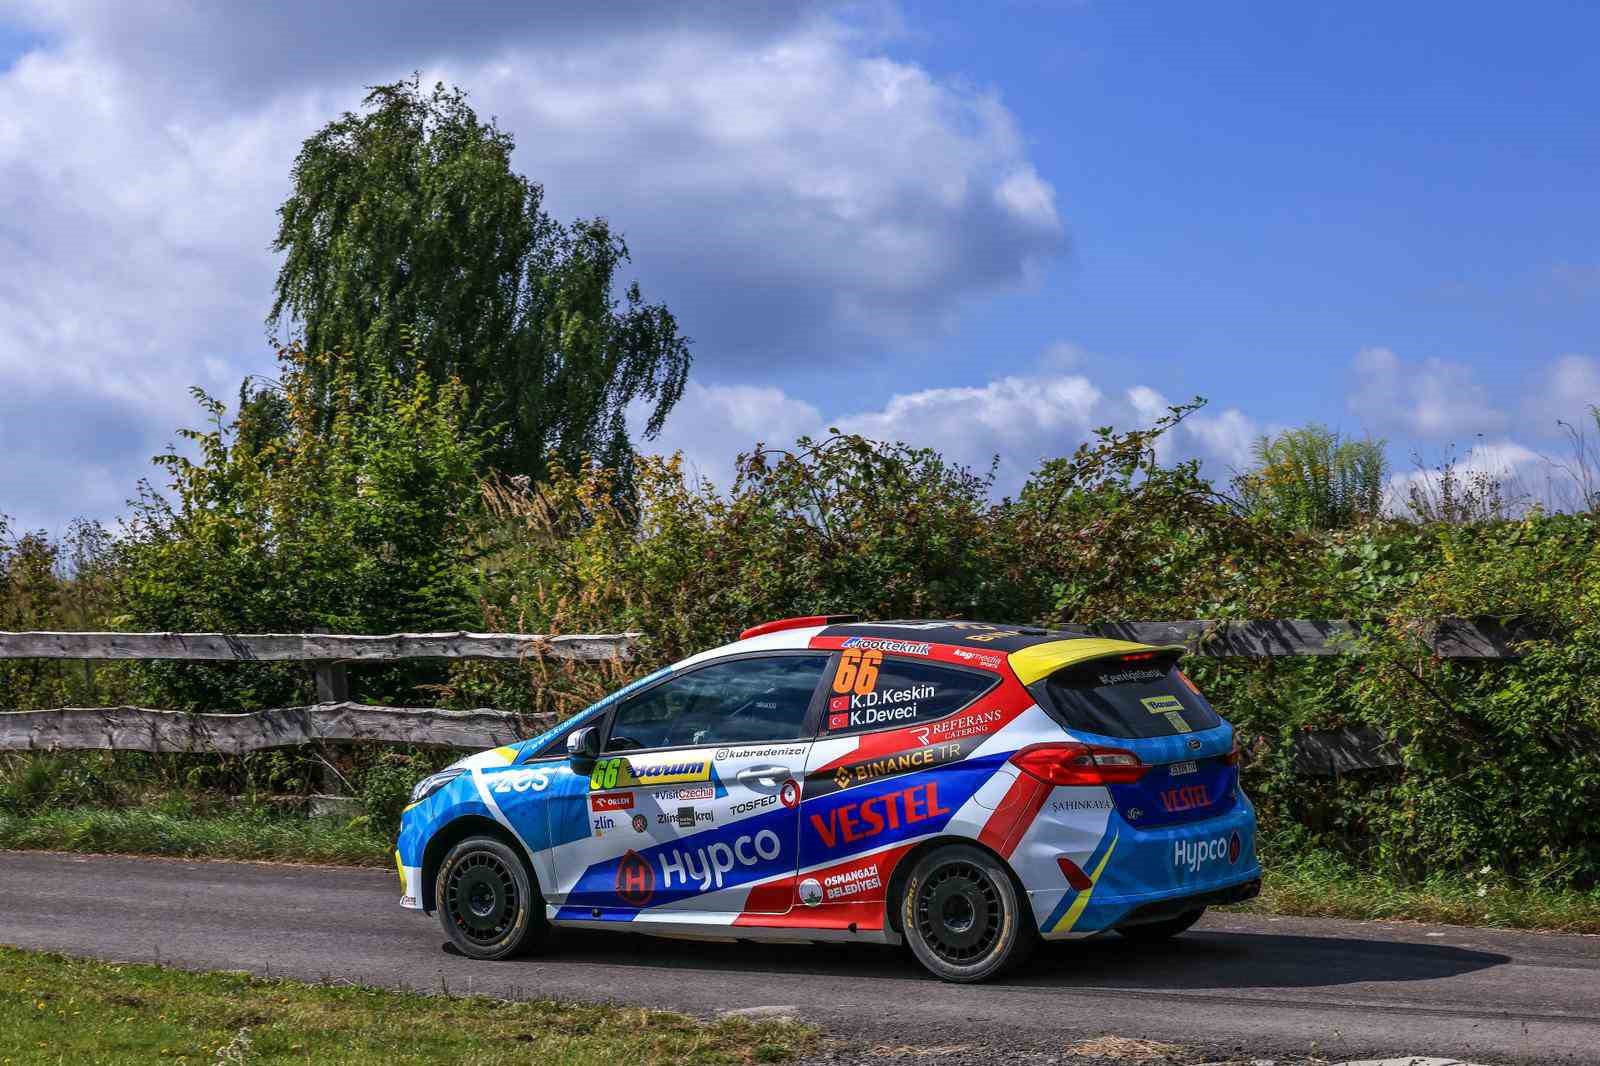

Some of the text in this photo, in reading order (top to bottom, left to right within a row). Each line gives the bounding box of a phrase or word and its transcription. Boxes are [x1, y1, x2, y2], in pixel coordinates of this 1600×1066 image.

[832, 648, 884, 695] 66
[851, 684, 935, 709] K.D.Keskin
[850, 703, 917, 726] K.Deveci
[933, 710, 1002, 734] REFERANS
[944, 725, 989, 740] CATERING
[590, 758, 621, 790] 66
[856, 750, 935, 781] BINANCE
[730, 795, 777, 815] TOSFED
[1160, 784, 1213, 813] VESTEL
[809, 782, 950, 848] VESTEL
[658, 829, 781, 891] Hypco
[1174, 837, 1228, 873] Hypco
